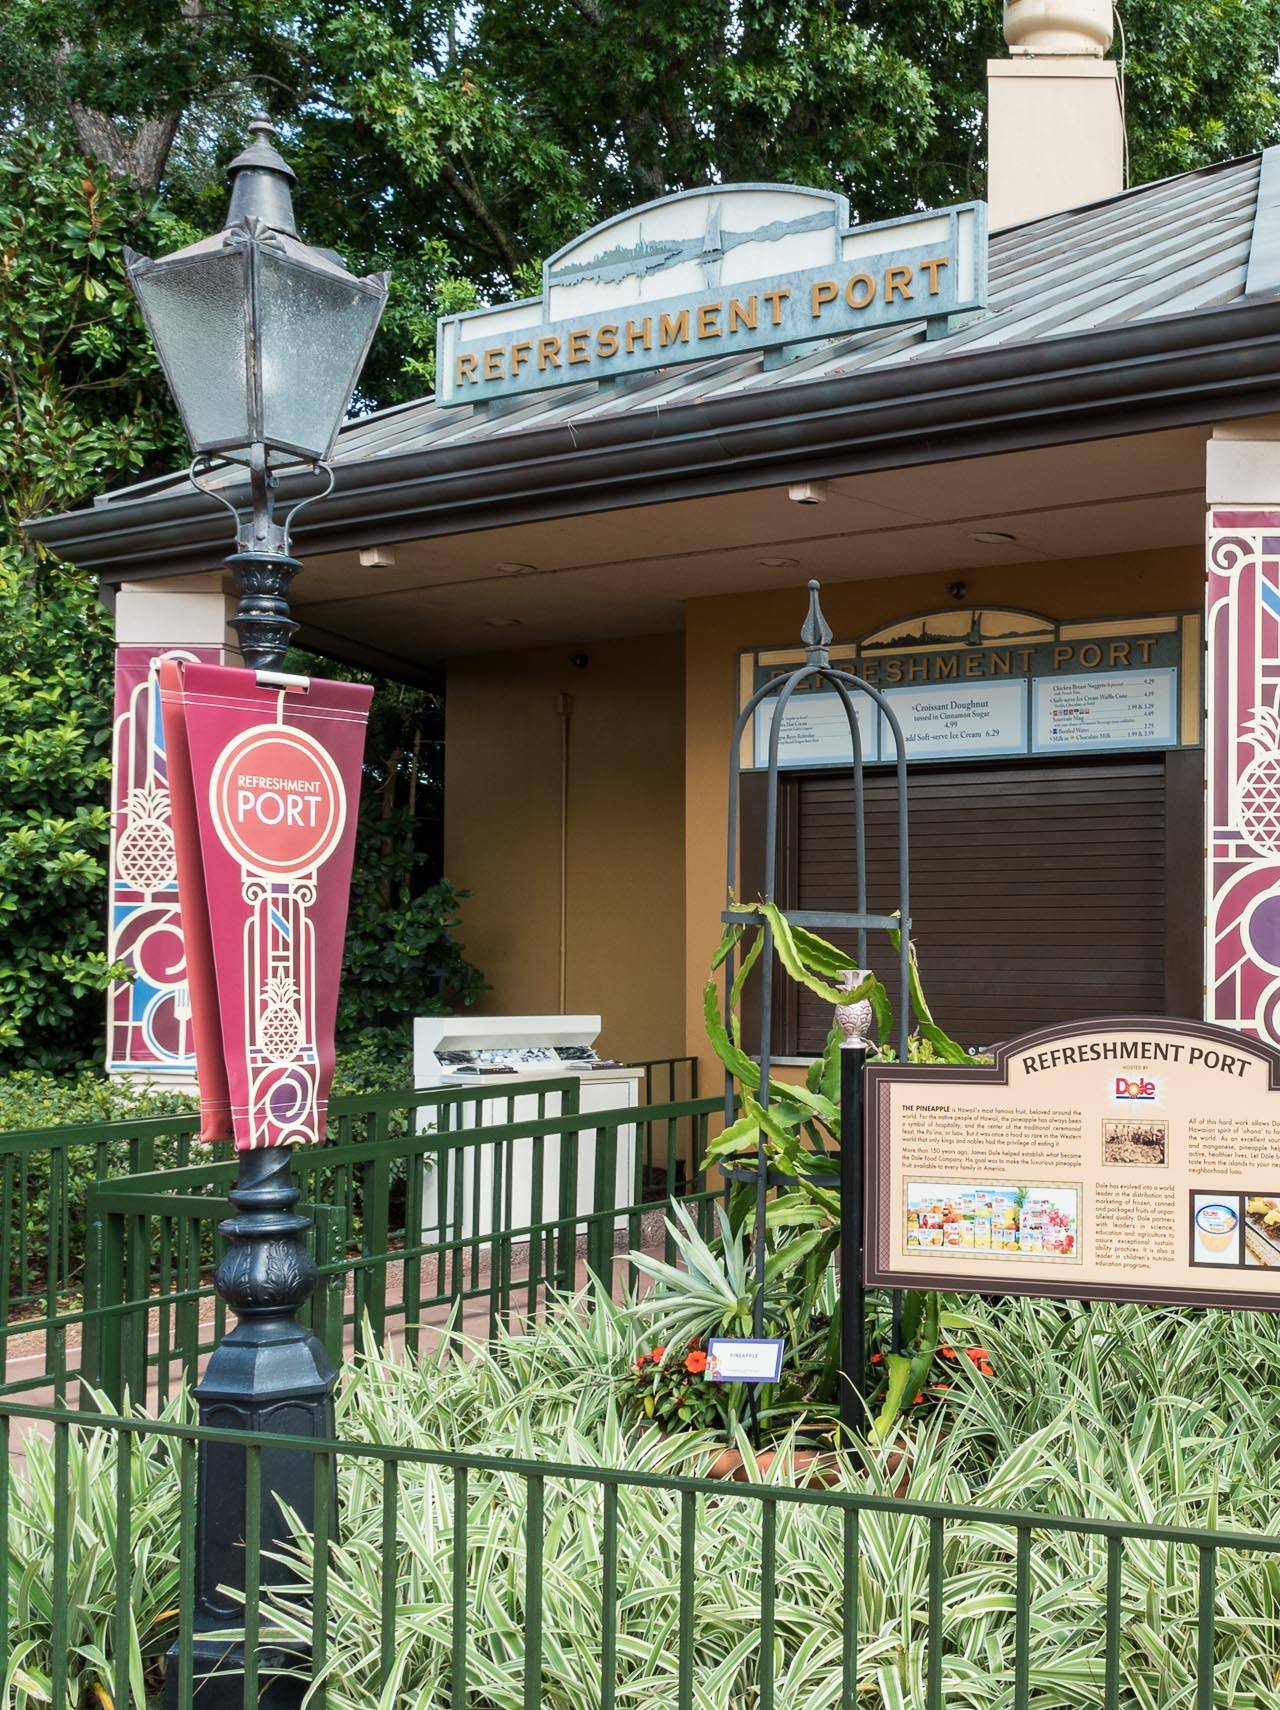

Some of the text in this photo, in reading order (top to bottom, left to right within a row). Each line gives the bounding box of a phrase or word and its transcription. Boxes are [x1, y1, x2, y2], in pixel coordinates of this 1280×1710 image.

[454, 256, 950, 387] REFRESHMENT PORT
[1053, 639, 1158, 672] PORT
[916, 700, 988, 712] Croissant Doughnut
[972, 711, 990, 719] Sugar
[917, 733, 948, 741] Soft-serve
[238, 774, 321, 794] REFRESHMENT
[238, 790, 322, 827] PORT
[1022, 1041, 1252, 1078] REFRESHMENT PORT
[1116, 1078, 1155, 1095] Dole
